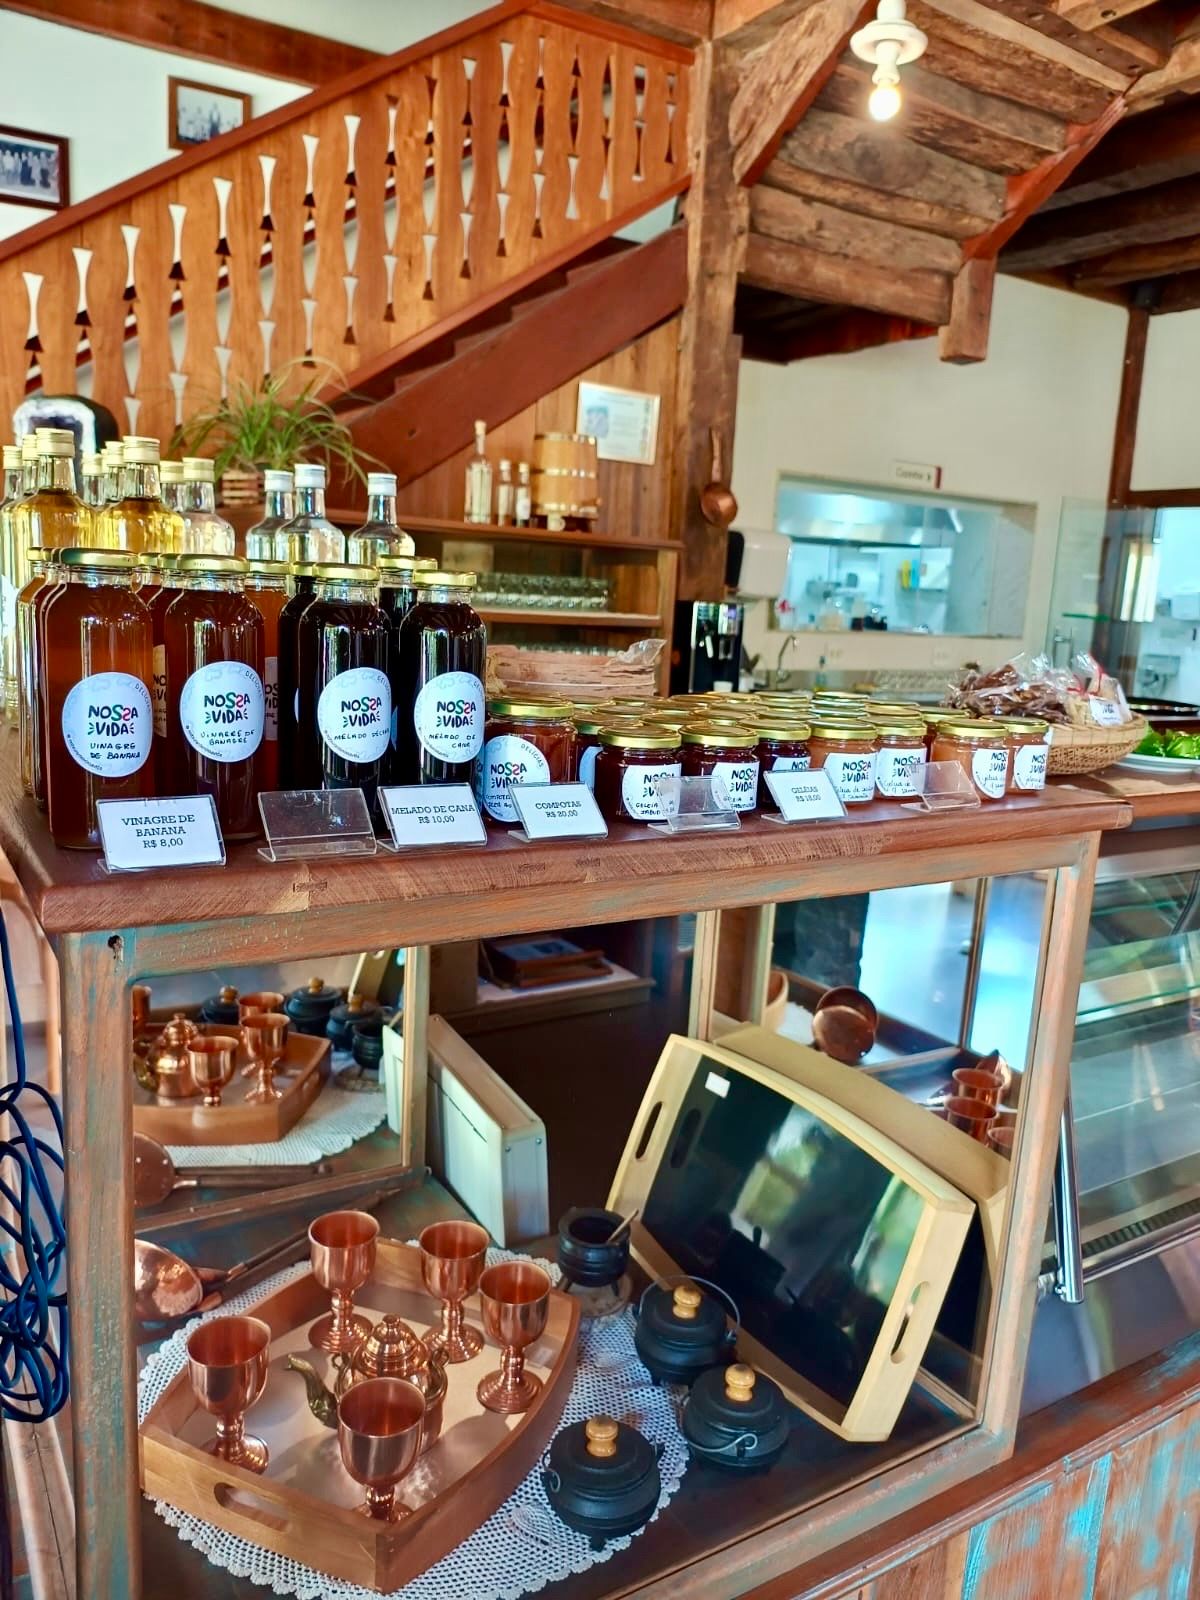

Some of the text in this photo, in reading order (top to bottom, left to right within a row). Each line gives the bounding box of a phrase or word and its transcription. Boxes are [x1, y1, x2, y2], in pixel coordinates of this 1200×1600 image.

[204, 692, 251, 709] NOSSA
[341, 696, 382, 712] NOSSA
[88, 704, 139, 721] NOSSA
[436, 700, 477, 715] NOSSA
[211, 709, 243, 724] VIDA
[348, 712, 377, 727] VIDA
[442, 715, 470, 728] VIDA
[95, 721, 129, 737] VIDA
[106, 751, 141, 760] BANANA
[490, 762, 527, 776] NOSSA
[842, 760, 872, 772] NOSSA
[847, 772, 866, 782] VIDA
[391, 806, 432, 815] MELADO
[448, 804, 475, 812] CANA
[535, 801, 582, 809] COMPOTAS
[418, 815, 455, 824] R$ 10,00
[558, 809, 578, 818] 20,00
[121, 814, 195, 826] VINAGRE DE
[136, 826, 187, 837] BANANA
[143, 838, 184, 849] R$ 8,00
